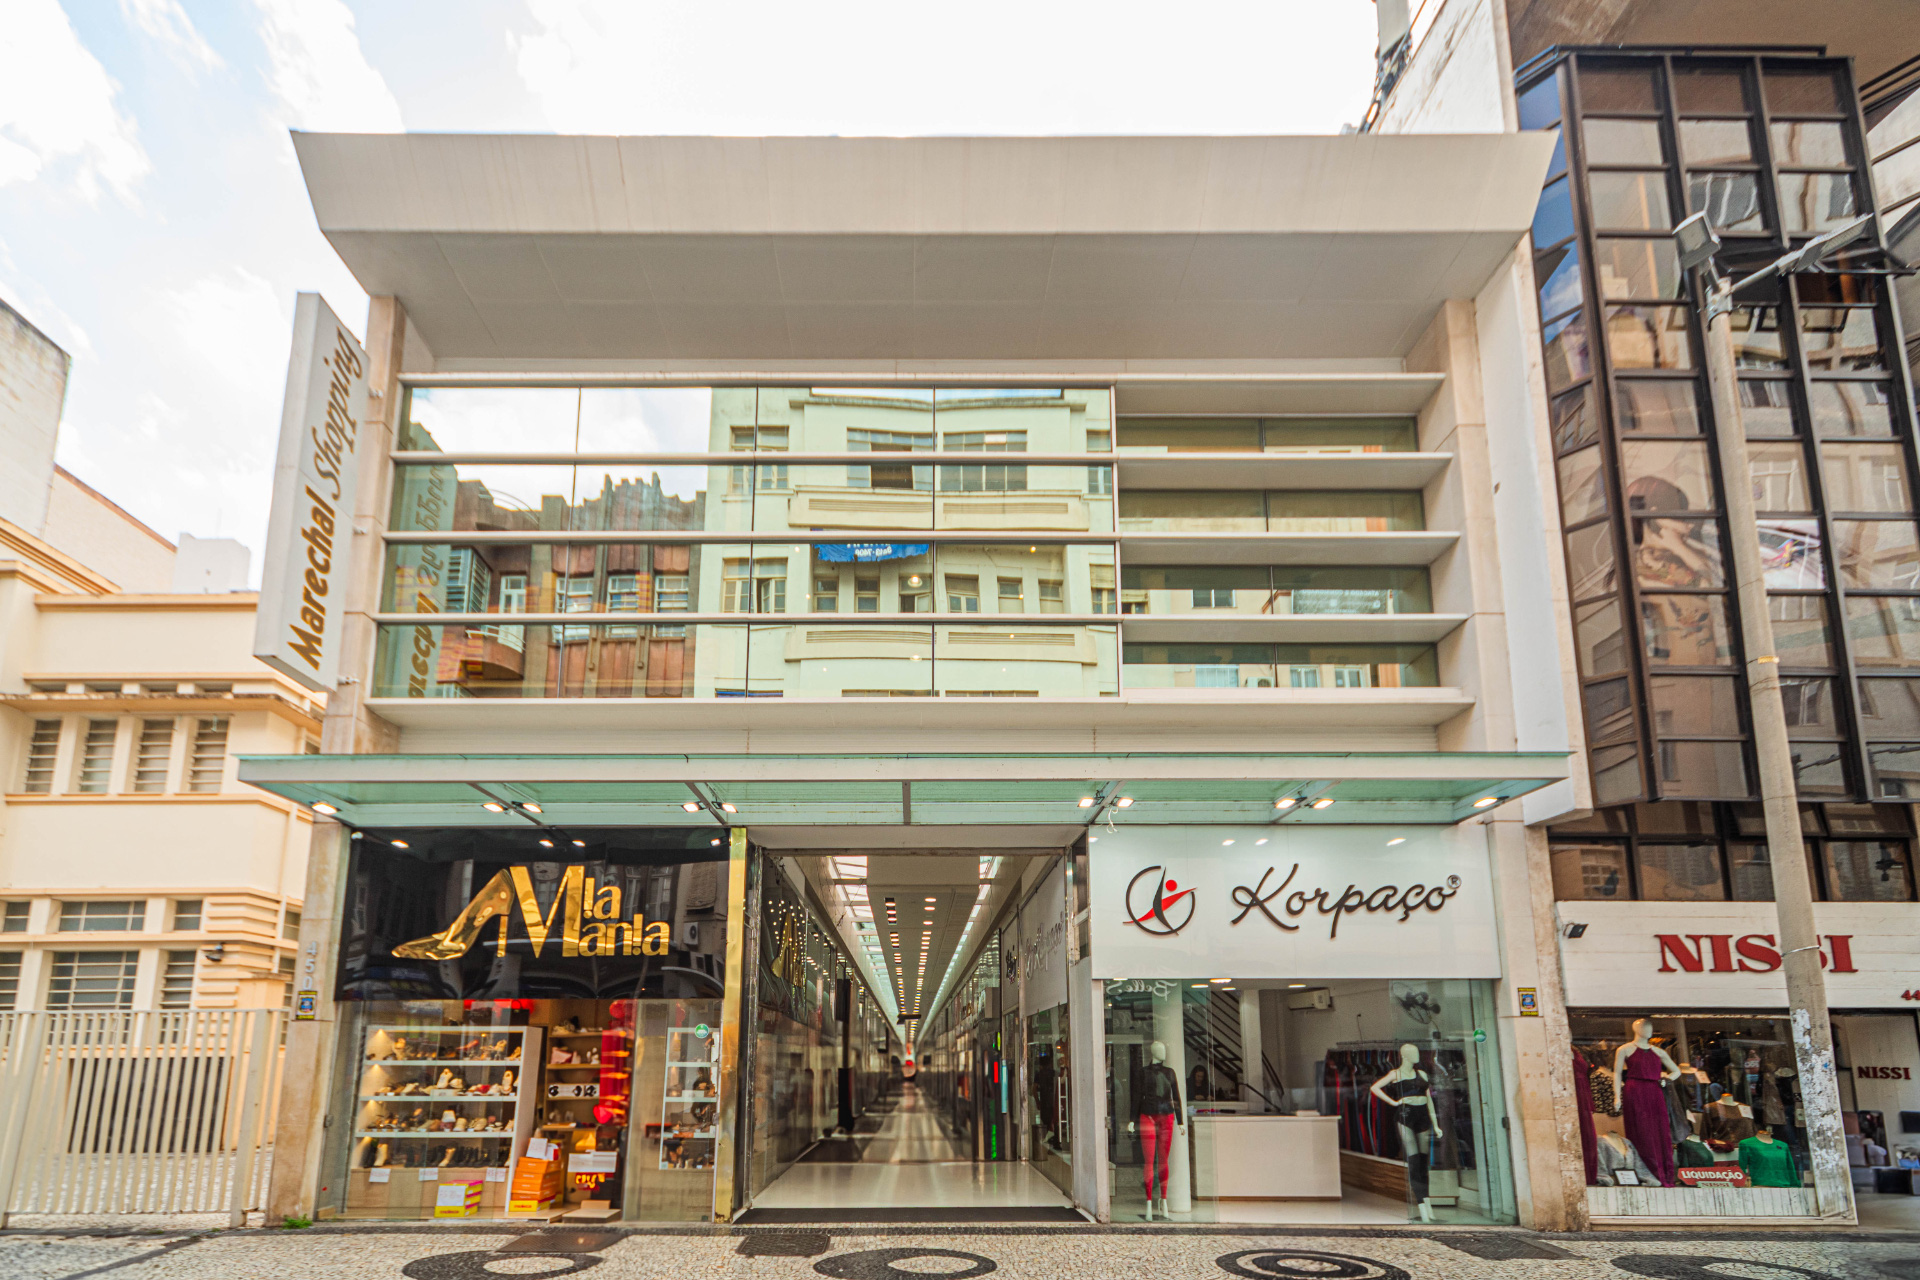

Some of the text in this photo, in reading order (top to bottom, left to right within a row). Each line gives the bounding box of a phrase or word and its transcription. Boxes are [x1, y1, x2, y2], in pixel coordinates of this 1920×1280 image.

[286, 326, 363, 671] Marechal Shopping
[1857, 1066, 1912, 1080] NISSI
[1681, 1170, 1743, 1182] LIQUIDAÇÃO
